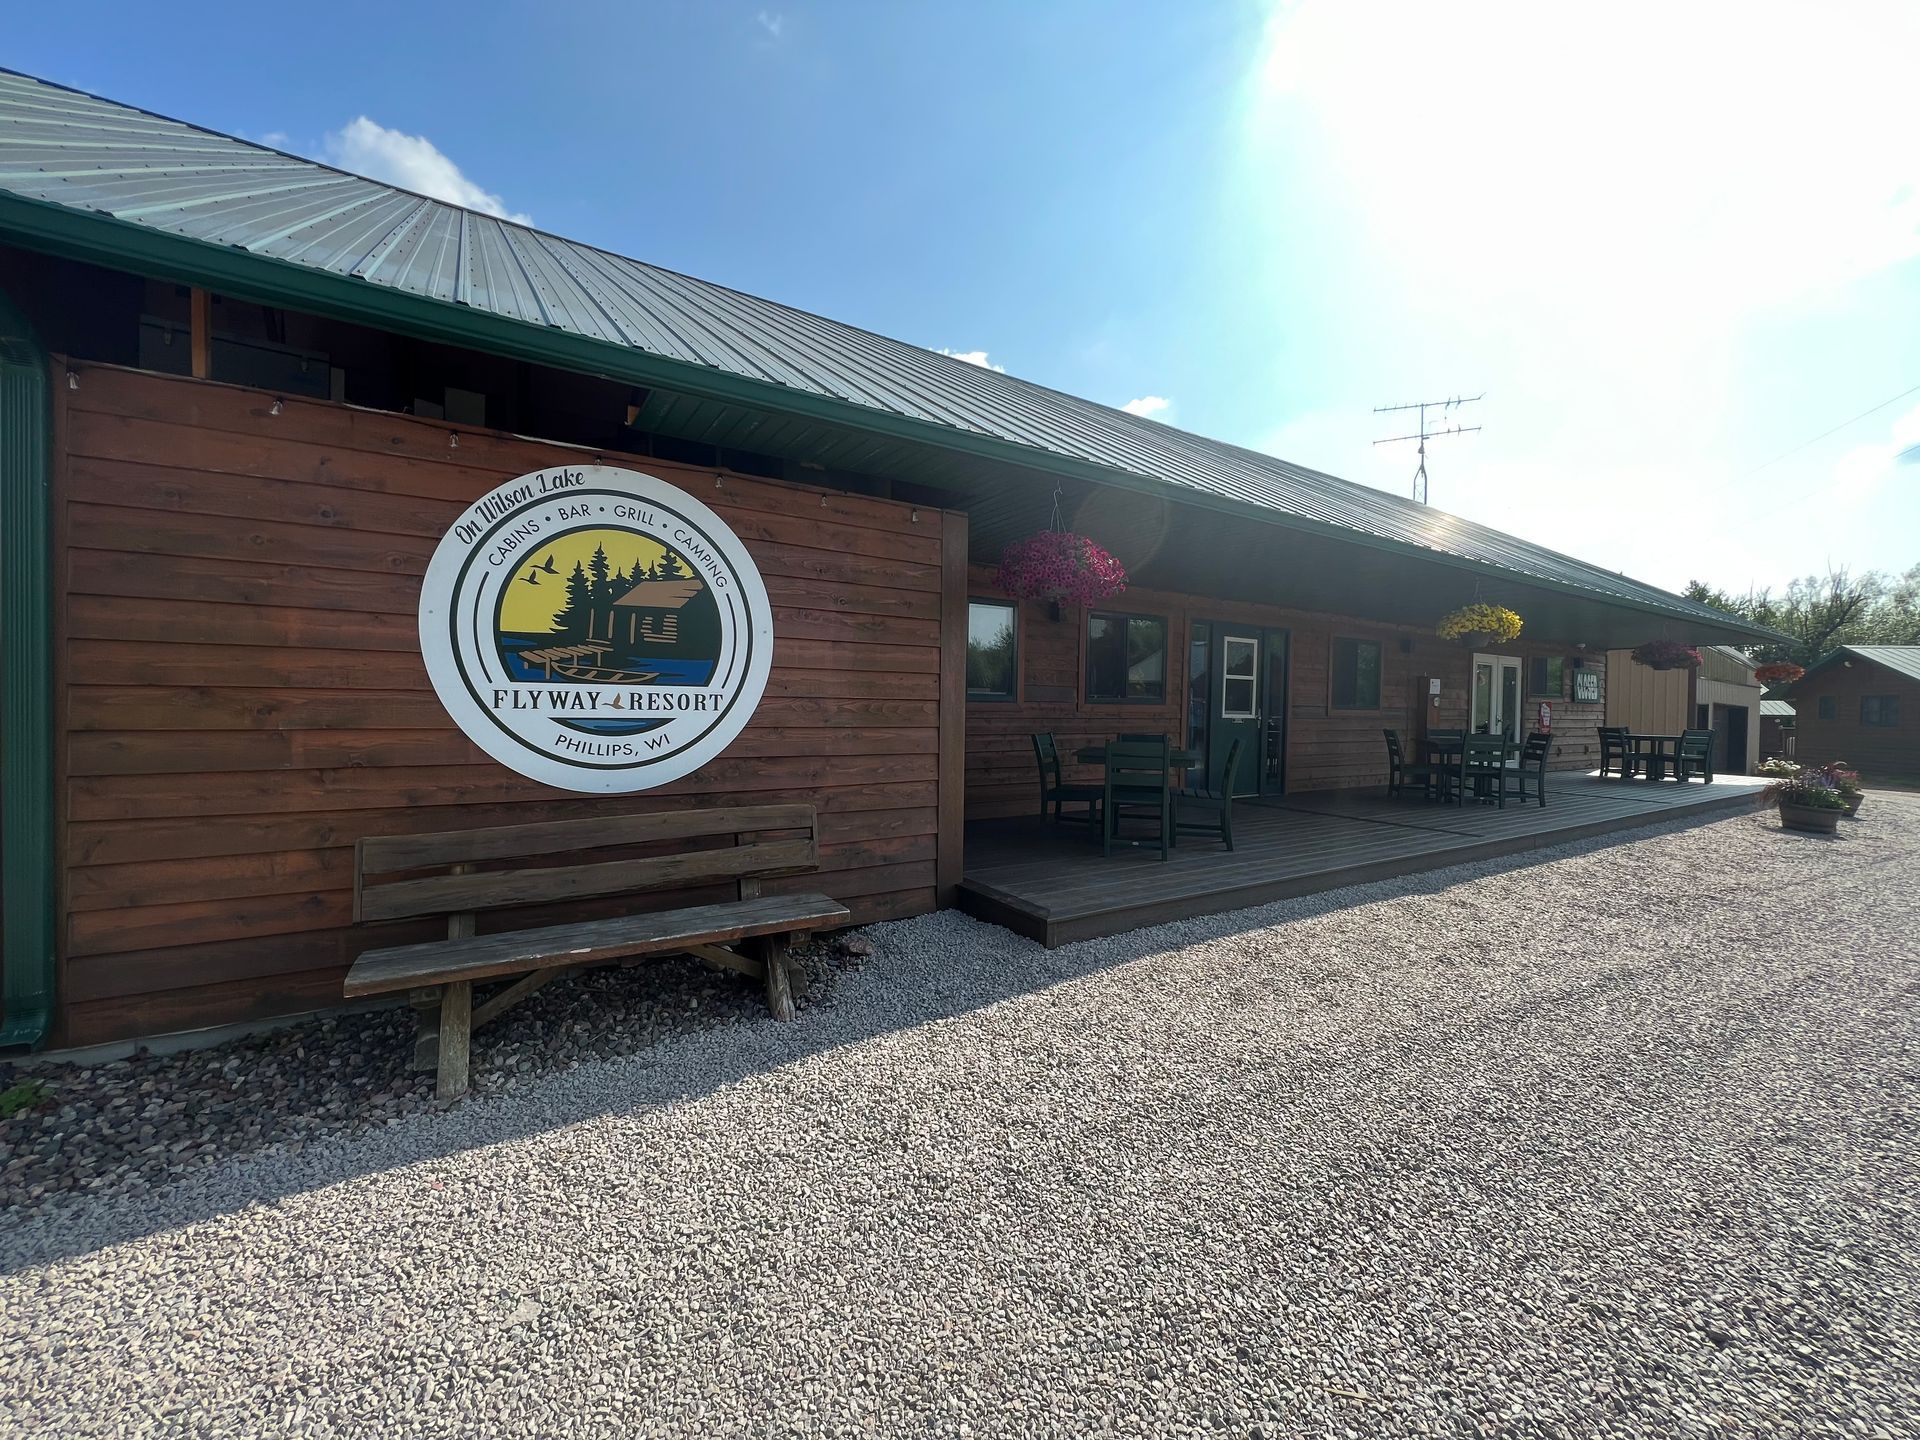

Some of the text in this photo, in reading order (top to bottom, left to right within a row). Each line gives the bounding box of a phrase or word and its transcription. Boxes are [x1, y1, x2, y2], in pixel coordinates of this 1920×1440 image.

[454, 468, 586, 545] On Wilson Lake
[488, 503, 728, 588] CABINS BAR GRILL CAMPING
[492, 689, 724, 711] FLYWAY RESORT
[554, 733, 671, 757] PHILLIPS, WI
